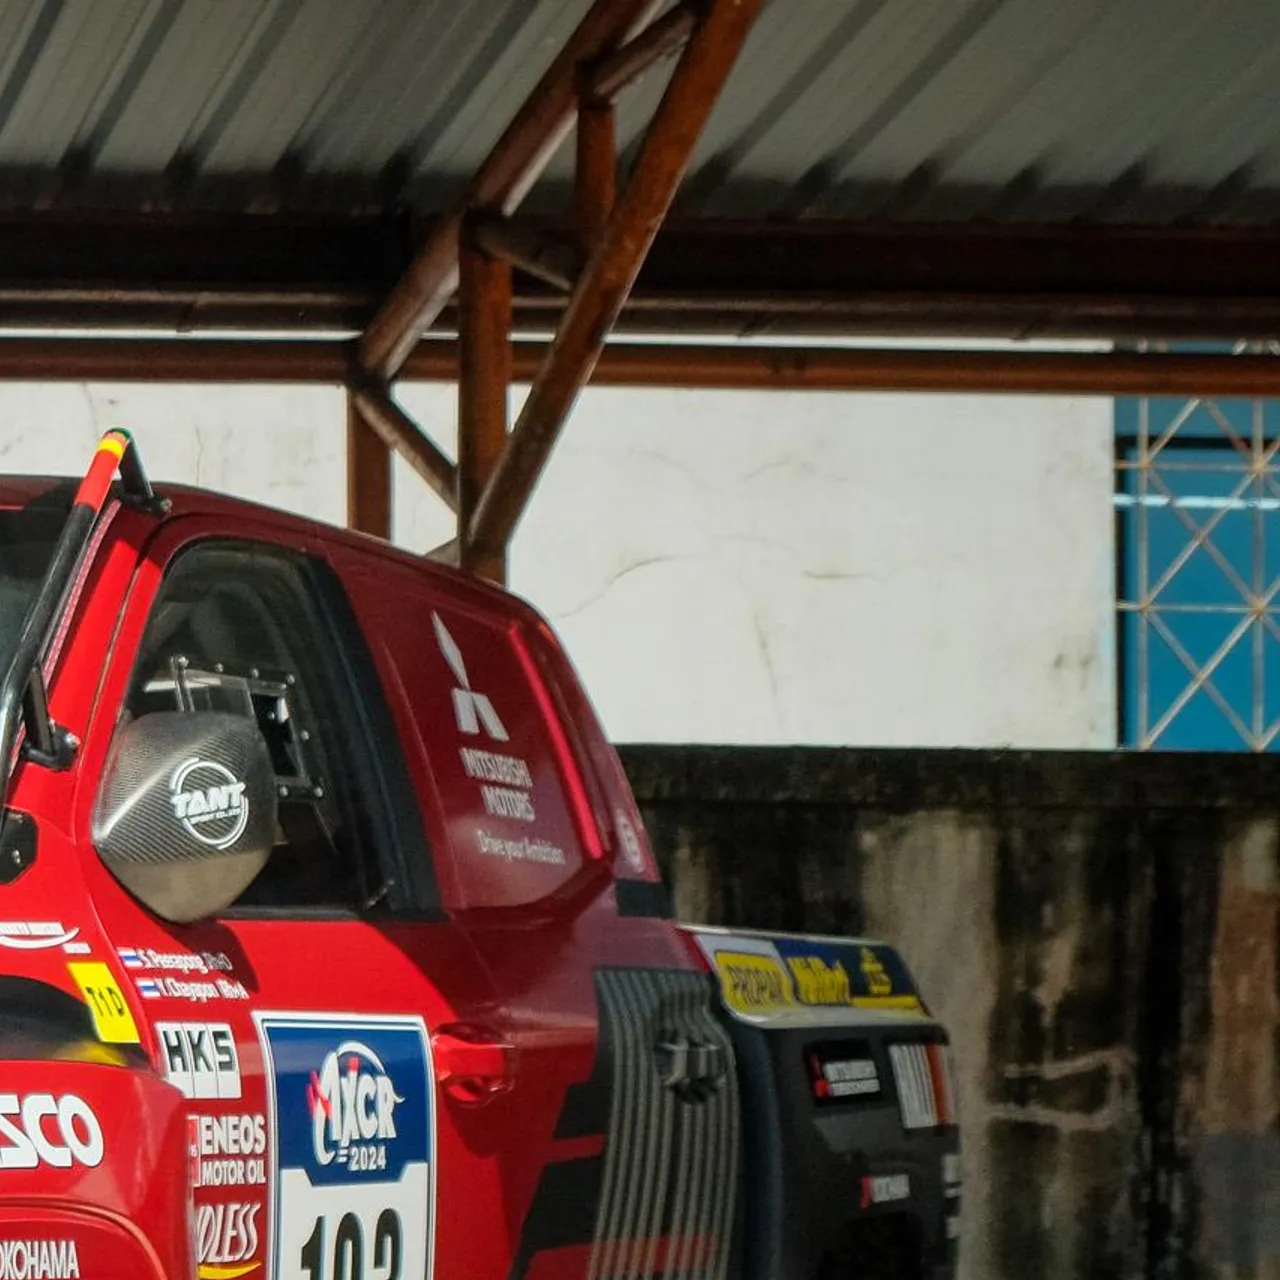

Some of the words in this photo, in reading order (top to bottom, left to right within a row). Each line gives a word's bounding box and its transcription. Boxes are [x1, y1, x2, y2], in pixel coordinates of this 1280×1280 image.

[162, 1028, 236, 1074] HKS
[199, 1114, 266, 1155] ENEOS
[201, 1159, 245, 1186] MOTOR
[247, 1159, 267, 1185] OIL
[347, 1146, 387, 1172] 2024
